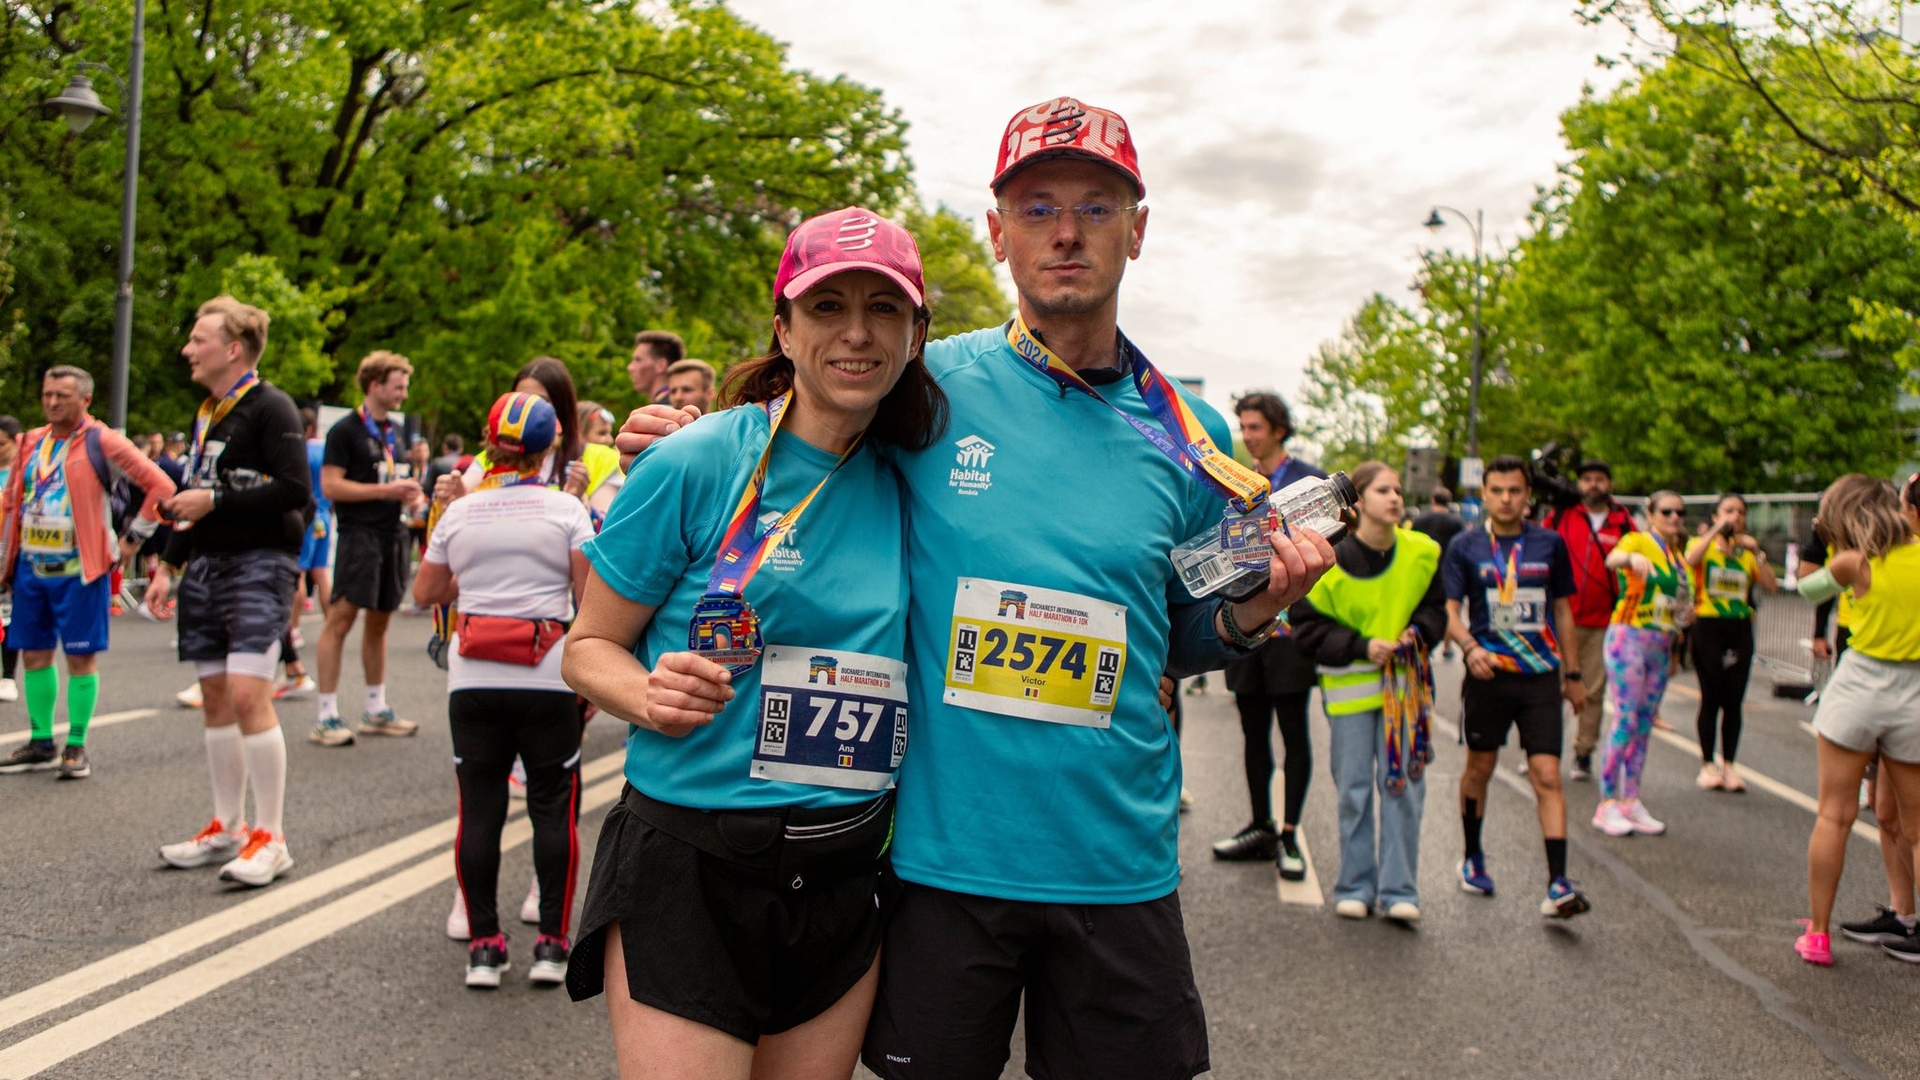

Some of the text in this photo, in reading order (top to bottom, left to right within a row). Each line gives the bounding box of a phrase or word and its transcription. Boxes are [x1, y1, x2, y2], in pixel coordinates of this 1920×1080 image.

[1016, 333, 1049, 371] 2024
[950, 468, 990, 482] Habitat
[770, 548, 802, 559] abitat
[1244, 551, 1269, 560] MARATHON
[1030, 602, 1089, 618] BUCHAREST INTERNATIONAL
[1029, 609, 1043, 618] HALF
[1043, 611, 1072, 623] MARATHON
[1079, 617, 1089, 626] 10K
[980, 628, 1087, 680] 2574
[841, 667, 865, 676] BUCHAREST
[840, 675, 853, 683] HALF
[854, 676, 879, 687] MARATHON
[1021, 675, 1046, 686] Victor
[805, 696, 884, 743] 757
[838, 744, 854, 753] Ana
